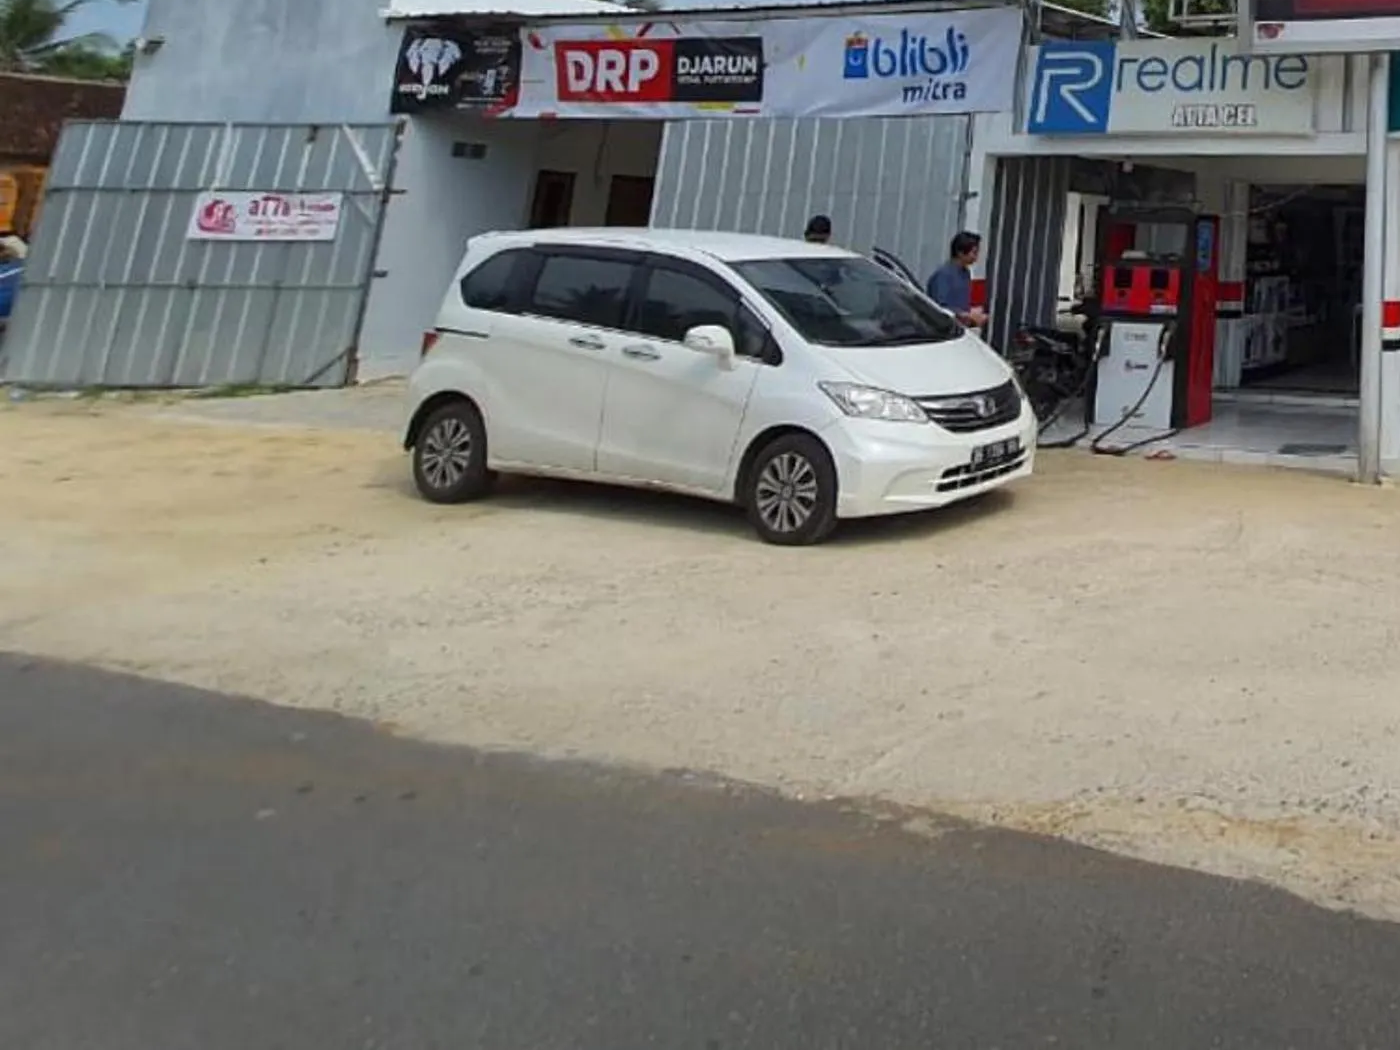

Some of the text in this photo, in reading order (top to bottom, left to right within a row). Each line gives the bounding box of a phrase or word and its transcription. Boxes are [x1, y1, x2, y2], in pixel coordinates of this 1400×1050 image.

[677, 55, 757, 75] DJARUM
[873, 25, 970, 78] blibli
[1117, 44, 1308, 92] realme
[565, 48, 660, 93] DRP
[902, 78, 967, 103] mitra
[1173, 104, 1218, 127] ATTA
